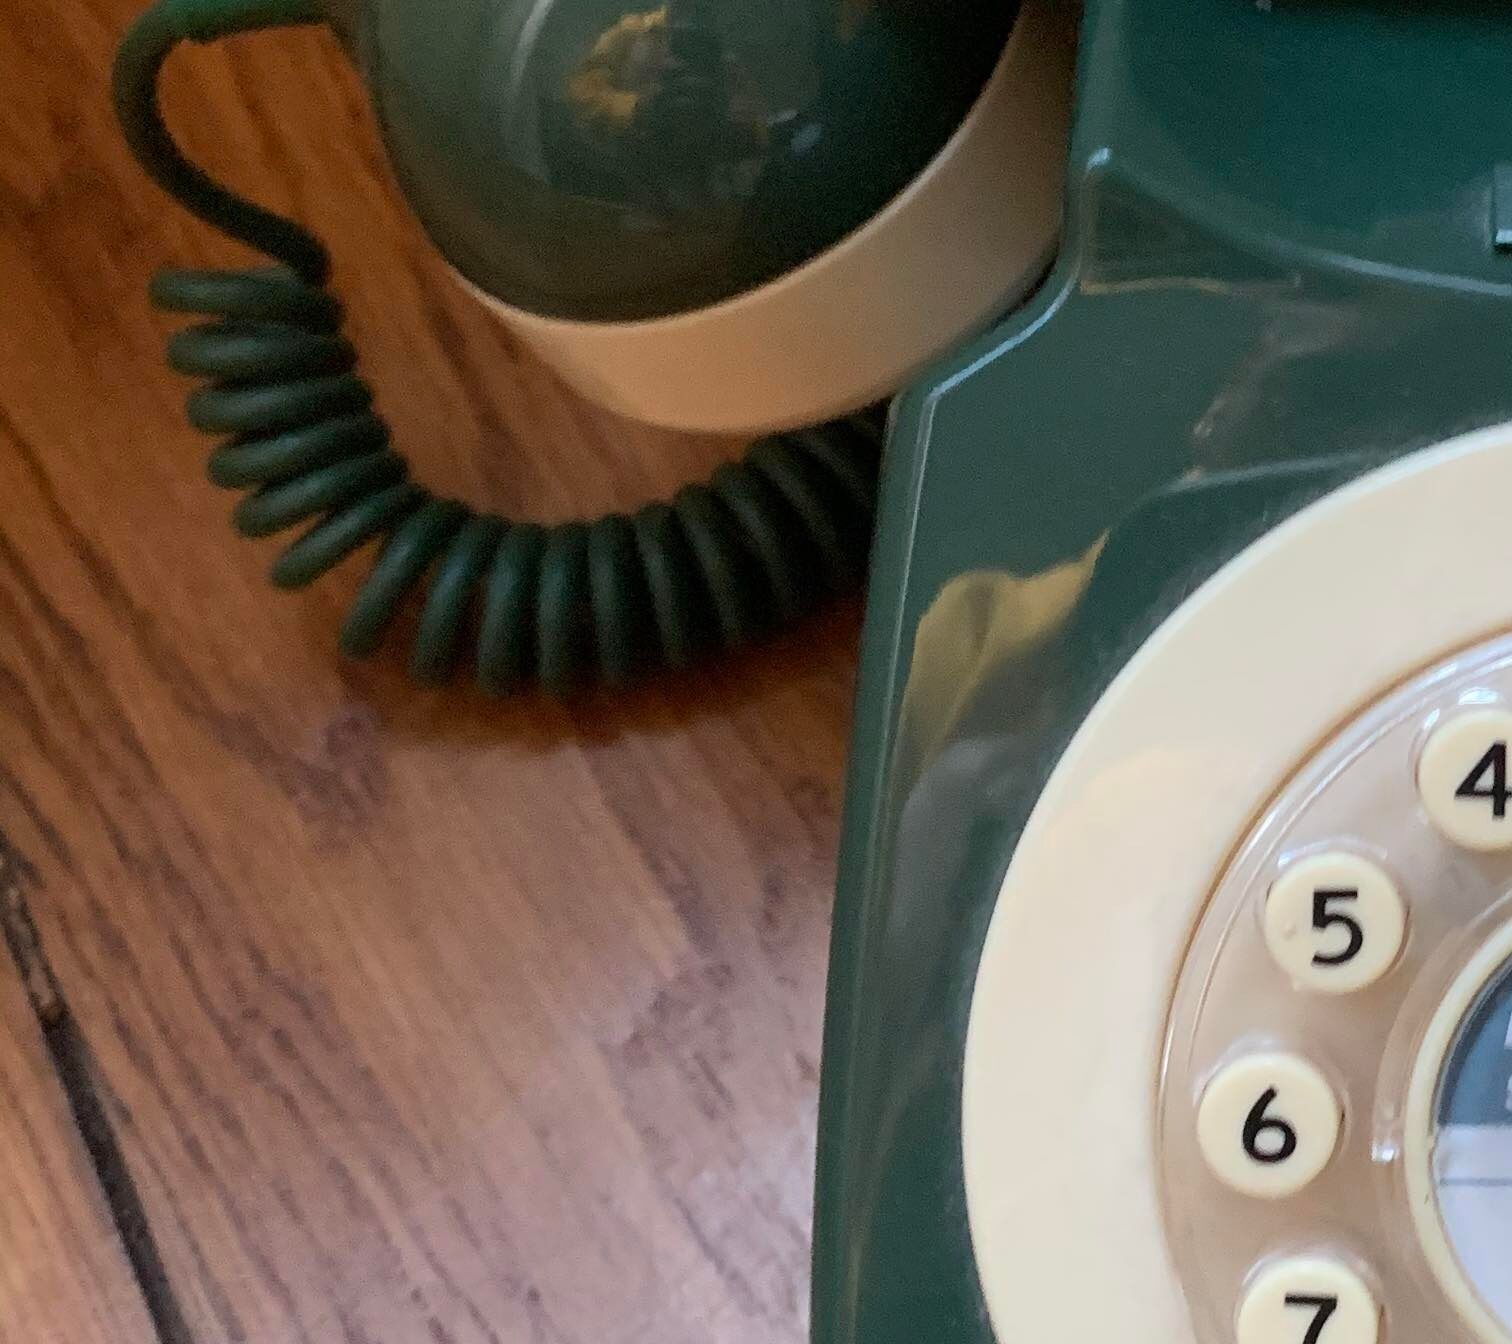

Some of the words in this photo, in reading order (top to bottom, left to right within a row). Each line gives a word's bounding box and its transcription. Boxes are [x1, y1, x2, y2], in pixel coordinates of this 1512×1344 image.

[1455, 742, 1512, 818] 4
[1312, 889, 1363, 966] 5
[1243, 1088, 1297, 1164] 6
